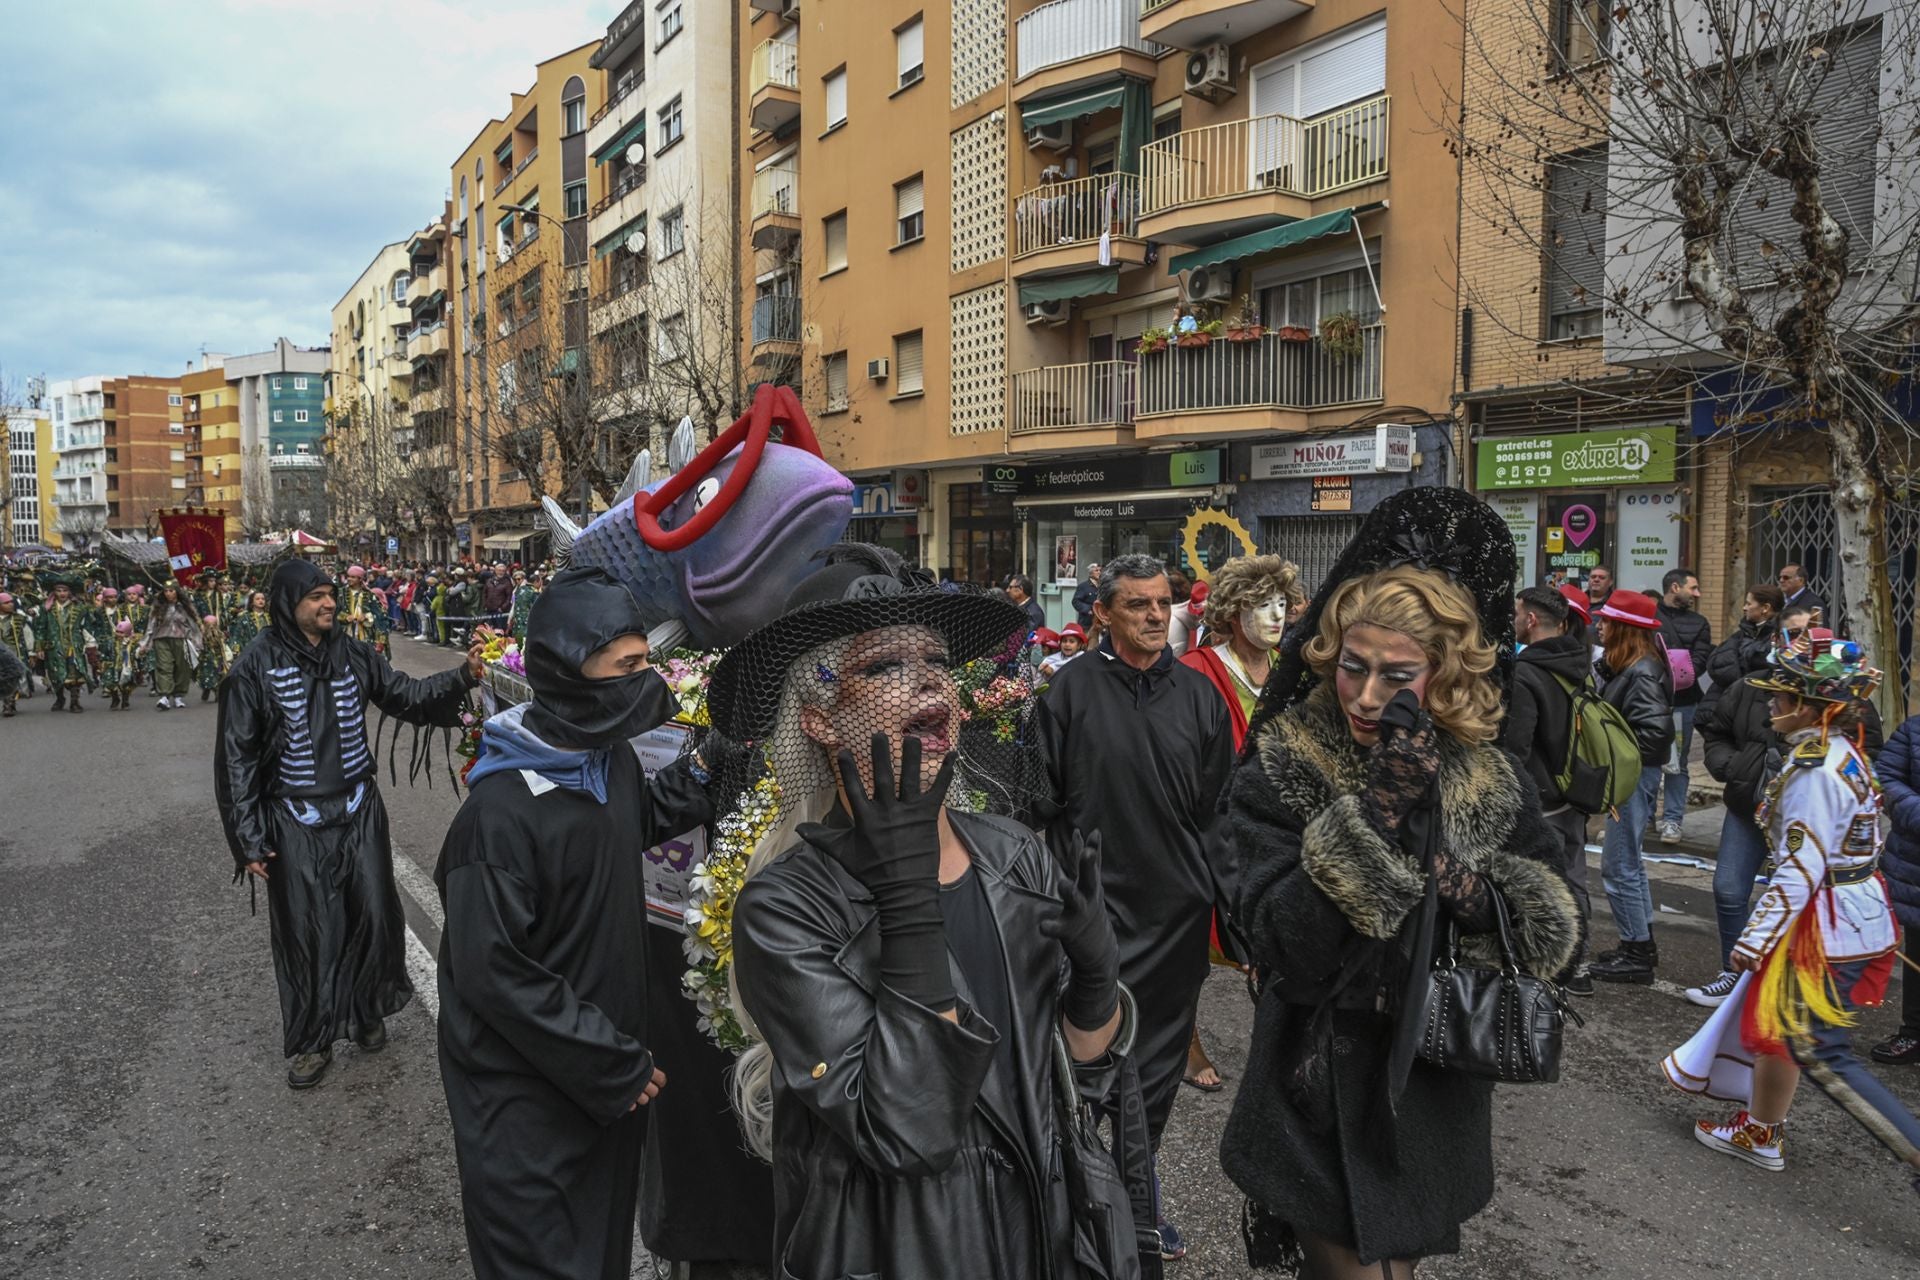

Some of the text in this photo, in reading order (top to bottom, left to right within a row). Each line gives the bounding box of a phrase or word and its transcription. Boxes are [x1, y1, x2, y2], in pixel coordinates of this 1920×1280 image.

[1496, 439, 1552, 451] extretel.es
[1294, 442, 1345, 463] MUÑOZ
[1496, 450, 1552, 462] 900 869 898
[1049, 460, 1205, 485] federópticos Luis
[1314, 476, 1350, 488] SE ALQUILA
[1074, 502, 1134, 518] federópticos Luis
[388, 539, 396, 549] P
[1636, 536, 1662, 544] Entra,
[1631, 547, 1655, 555] estás
